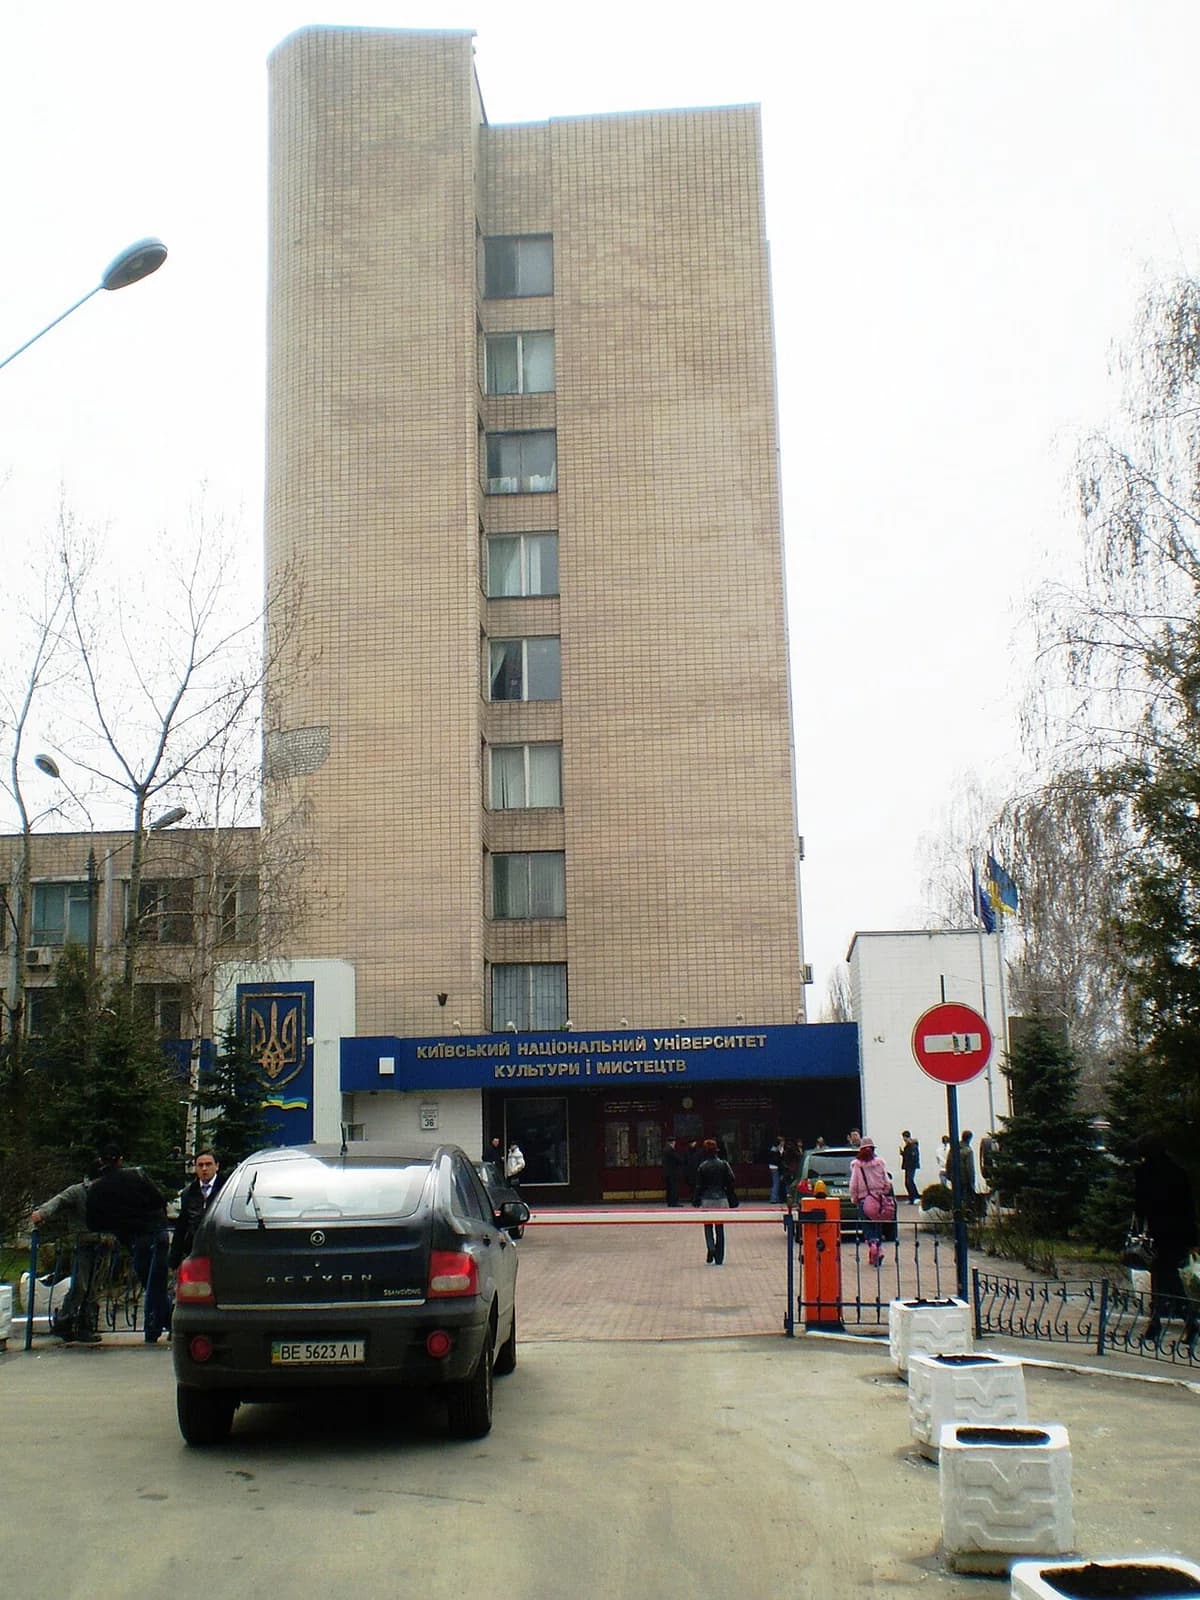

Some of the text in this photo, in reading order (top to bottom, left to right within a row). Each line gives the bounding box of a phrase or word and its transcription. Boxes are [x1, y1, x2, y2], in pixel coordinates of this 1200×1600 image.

[416, 1041, 510, 1058] КИЇВСЬКИЙ
[494, 1062, 580, 1078] КУЛЬТУРИ
[596, 1059, 688, 1075] МИСТЕЦТВ
[265, 1273, 373, 1283] ACTYON
[281, 1345, 302, 1360] BE
[305, 1344, 336, 1359] 5623
